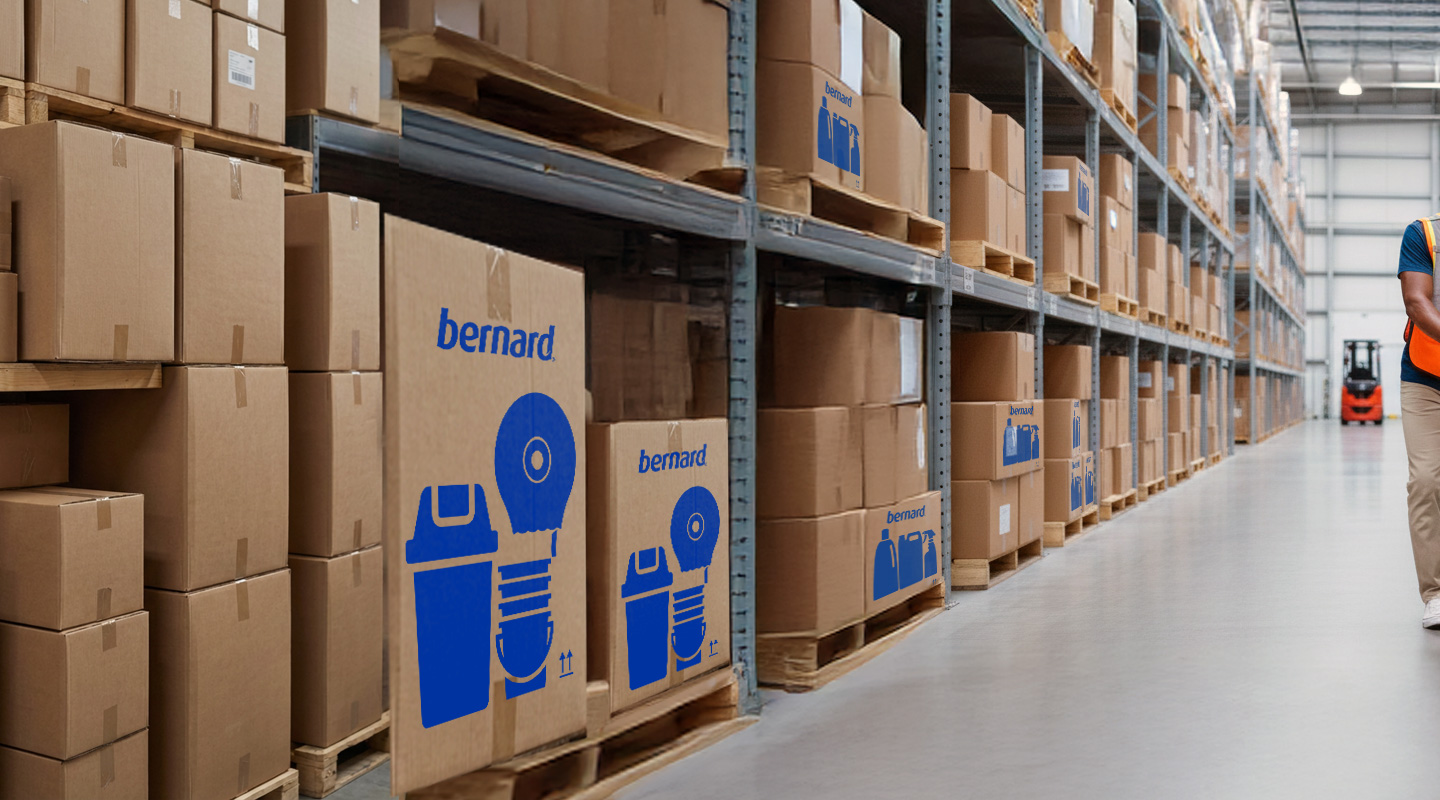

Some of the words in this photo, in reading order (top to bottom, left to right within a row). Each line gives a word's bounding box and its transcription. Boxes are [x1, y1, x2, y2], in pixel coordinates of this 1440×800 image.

[826, 81, 853, 107] bernard
[437, 307, 555, 362] bernard
[638, 444, 707, 474] bernard
[887, 505, 925, 523] bernard
